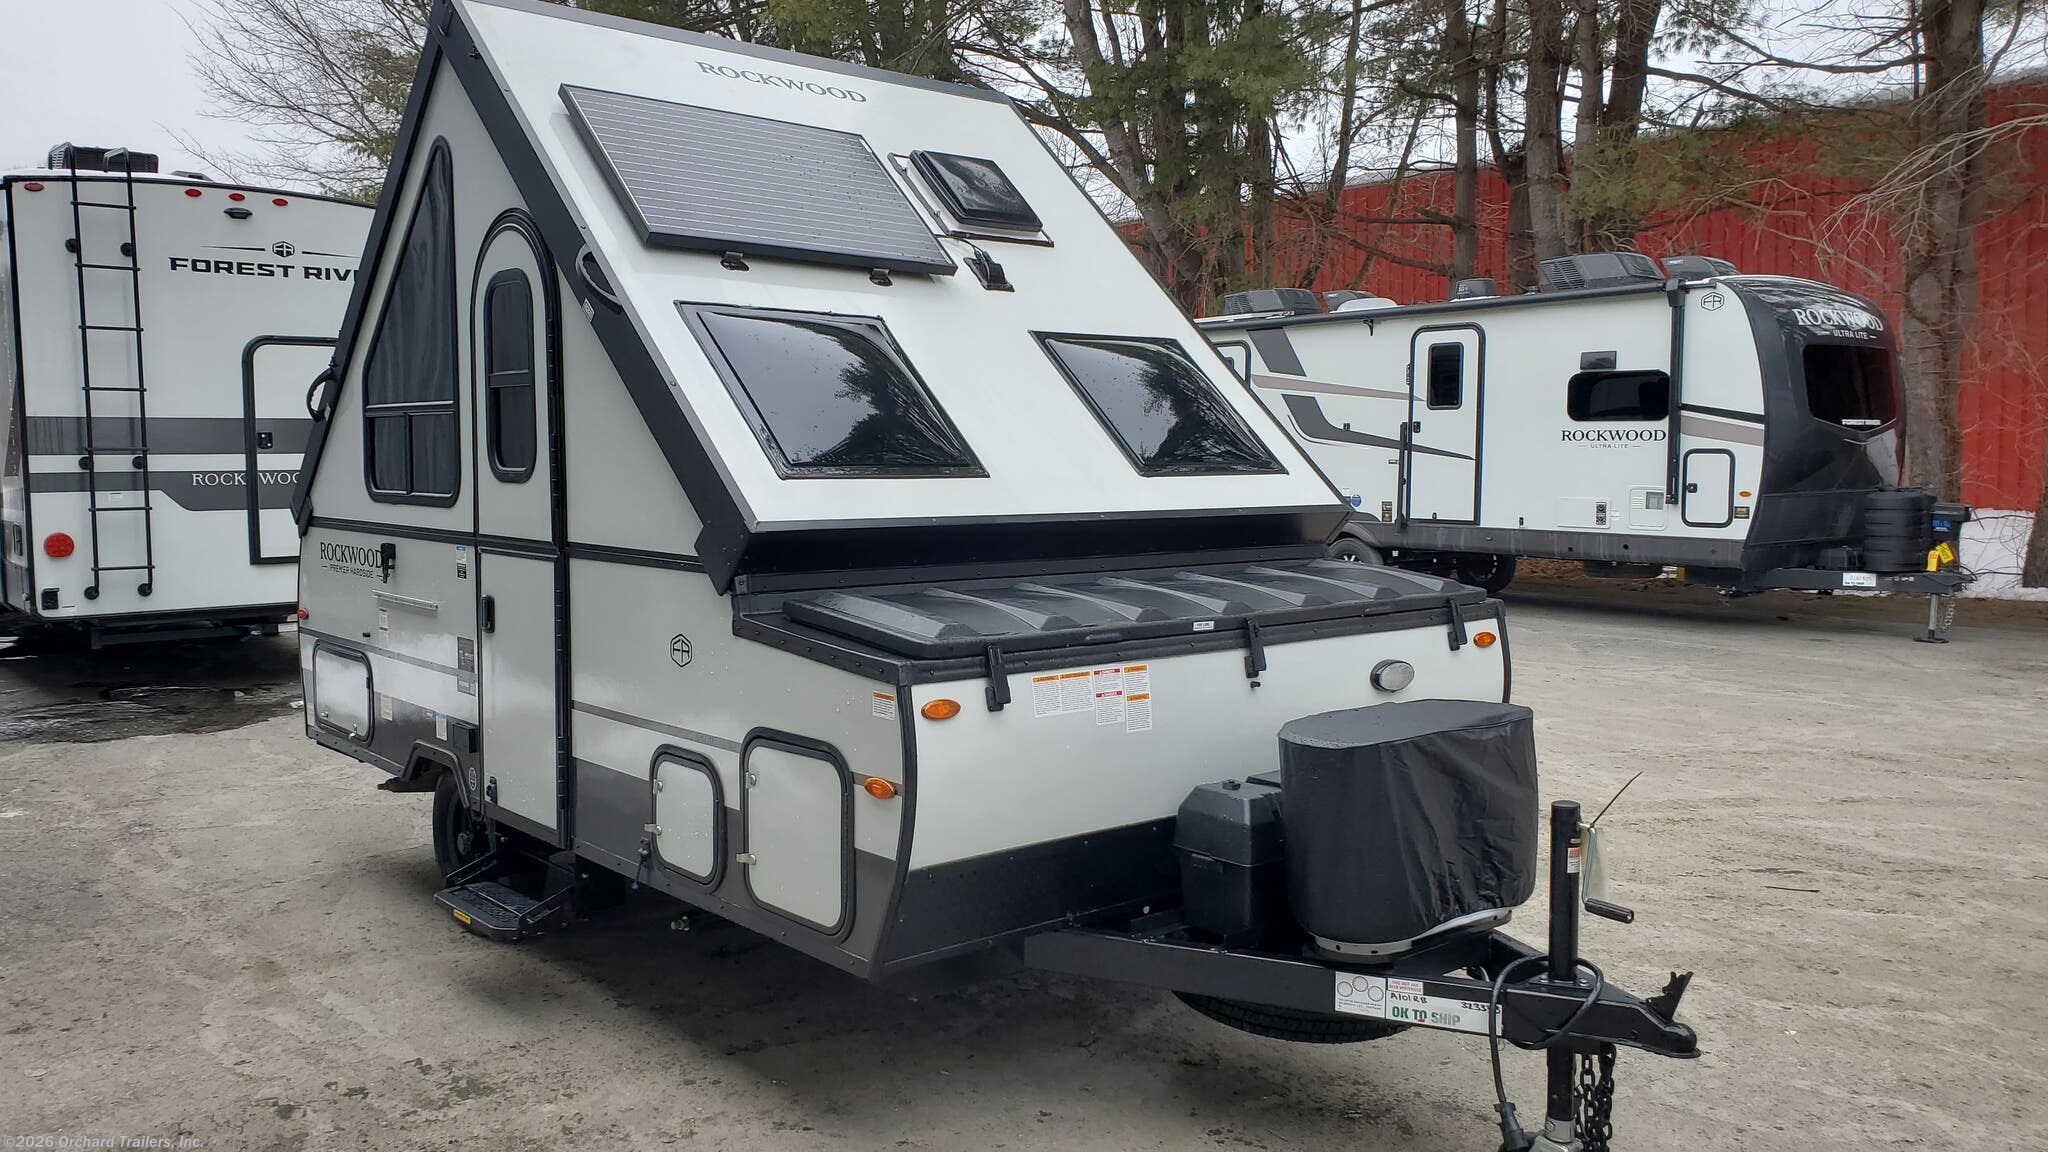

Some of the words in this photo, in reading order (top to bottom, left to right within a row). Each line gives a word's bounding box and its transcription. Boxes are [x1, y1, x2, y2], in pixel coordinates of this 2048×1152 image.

[696, 61, 867, 103] ROCKWOOD
[168, 256, 295, 278] FOREST
[302, 266, 359, 282] RIV
[1791, 308, 1884, 331] ROCKWOOD
[1832, 329, 1854, 338] ULTRA
[1855, 331, 1869, 339] LITE
[1561, 429, 1667, 442] ROCKWOOD
[319, 541, 382, 569] ROCKWOOD
[1392, 1006, 1409, 1019] OK
[1412, 1008, 1428, 1020] TO
[1430, 1011, 1461, 1026] SHIP
